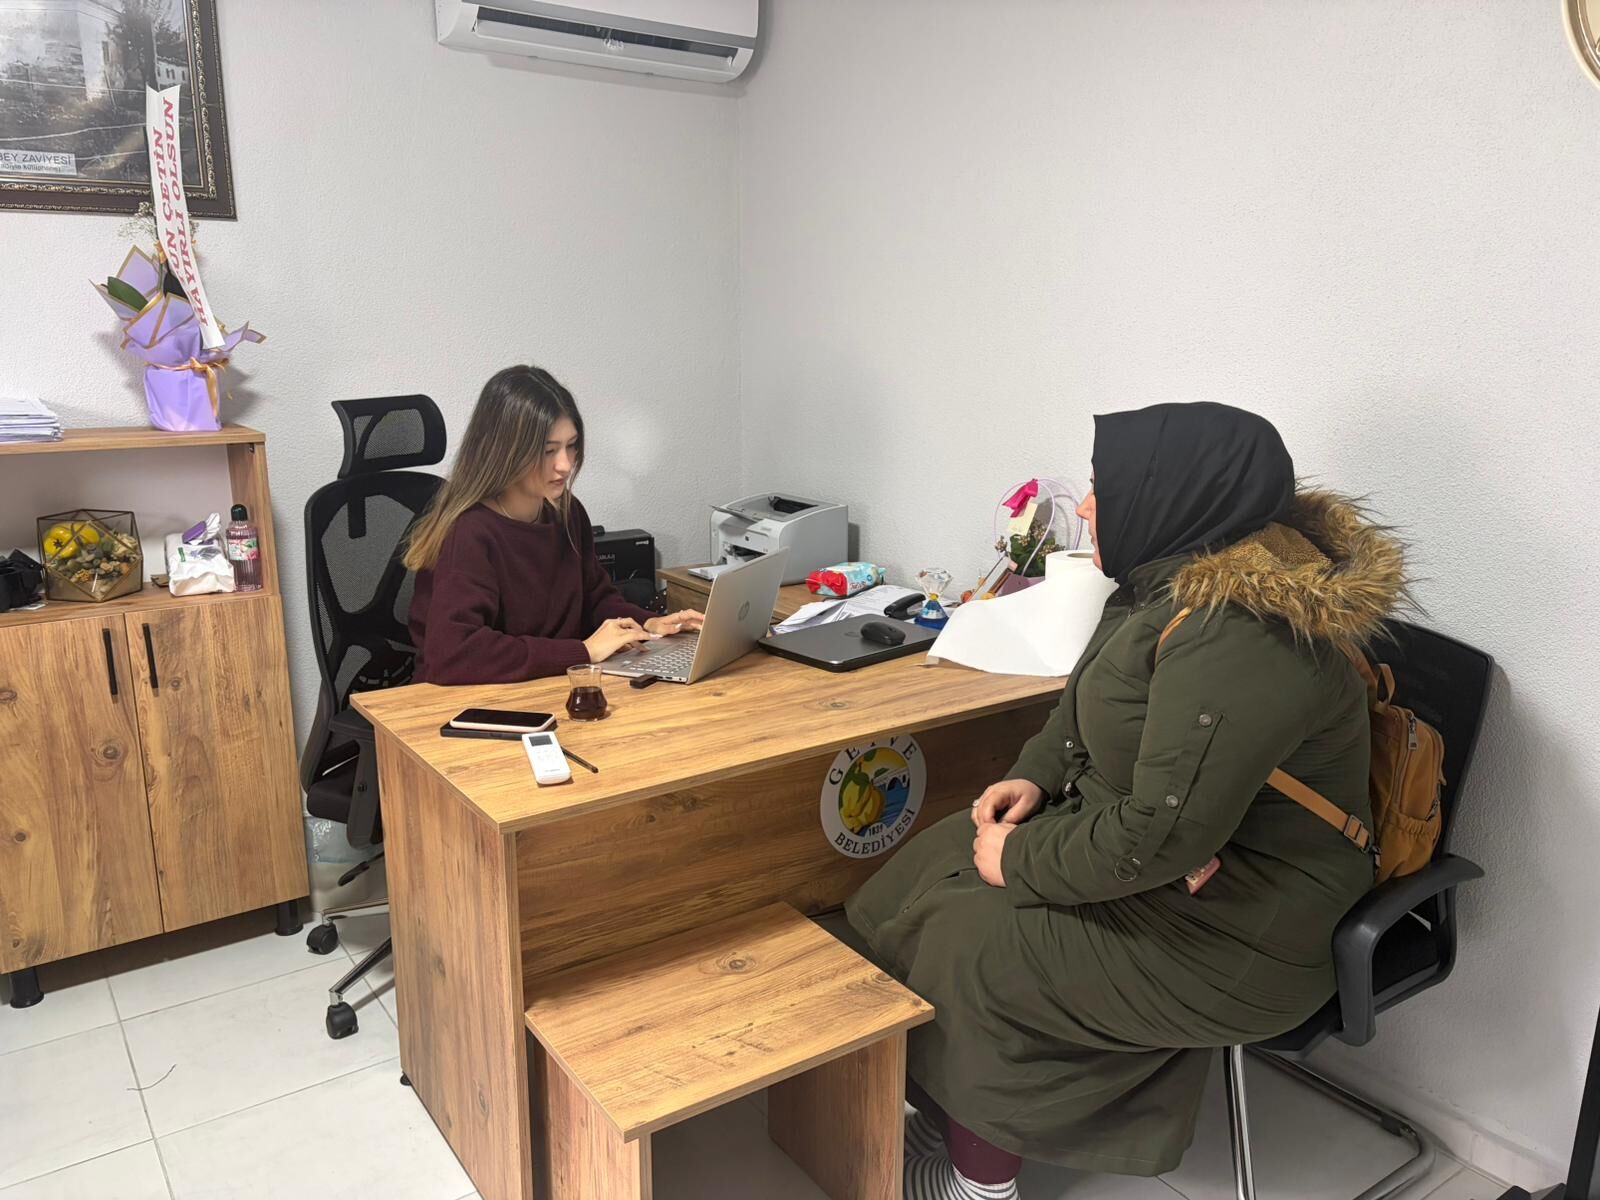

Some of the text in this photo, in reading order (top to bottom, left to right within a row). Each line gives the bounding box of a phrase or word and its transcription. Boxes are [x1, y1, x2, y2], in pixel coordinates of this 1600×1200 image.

[22, 153, 71, 165] ZAVİYESİ
[153, 127, 173, 222] ÇETİN
[163, 97, 208, 326] HAYIRLI OLSUN
